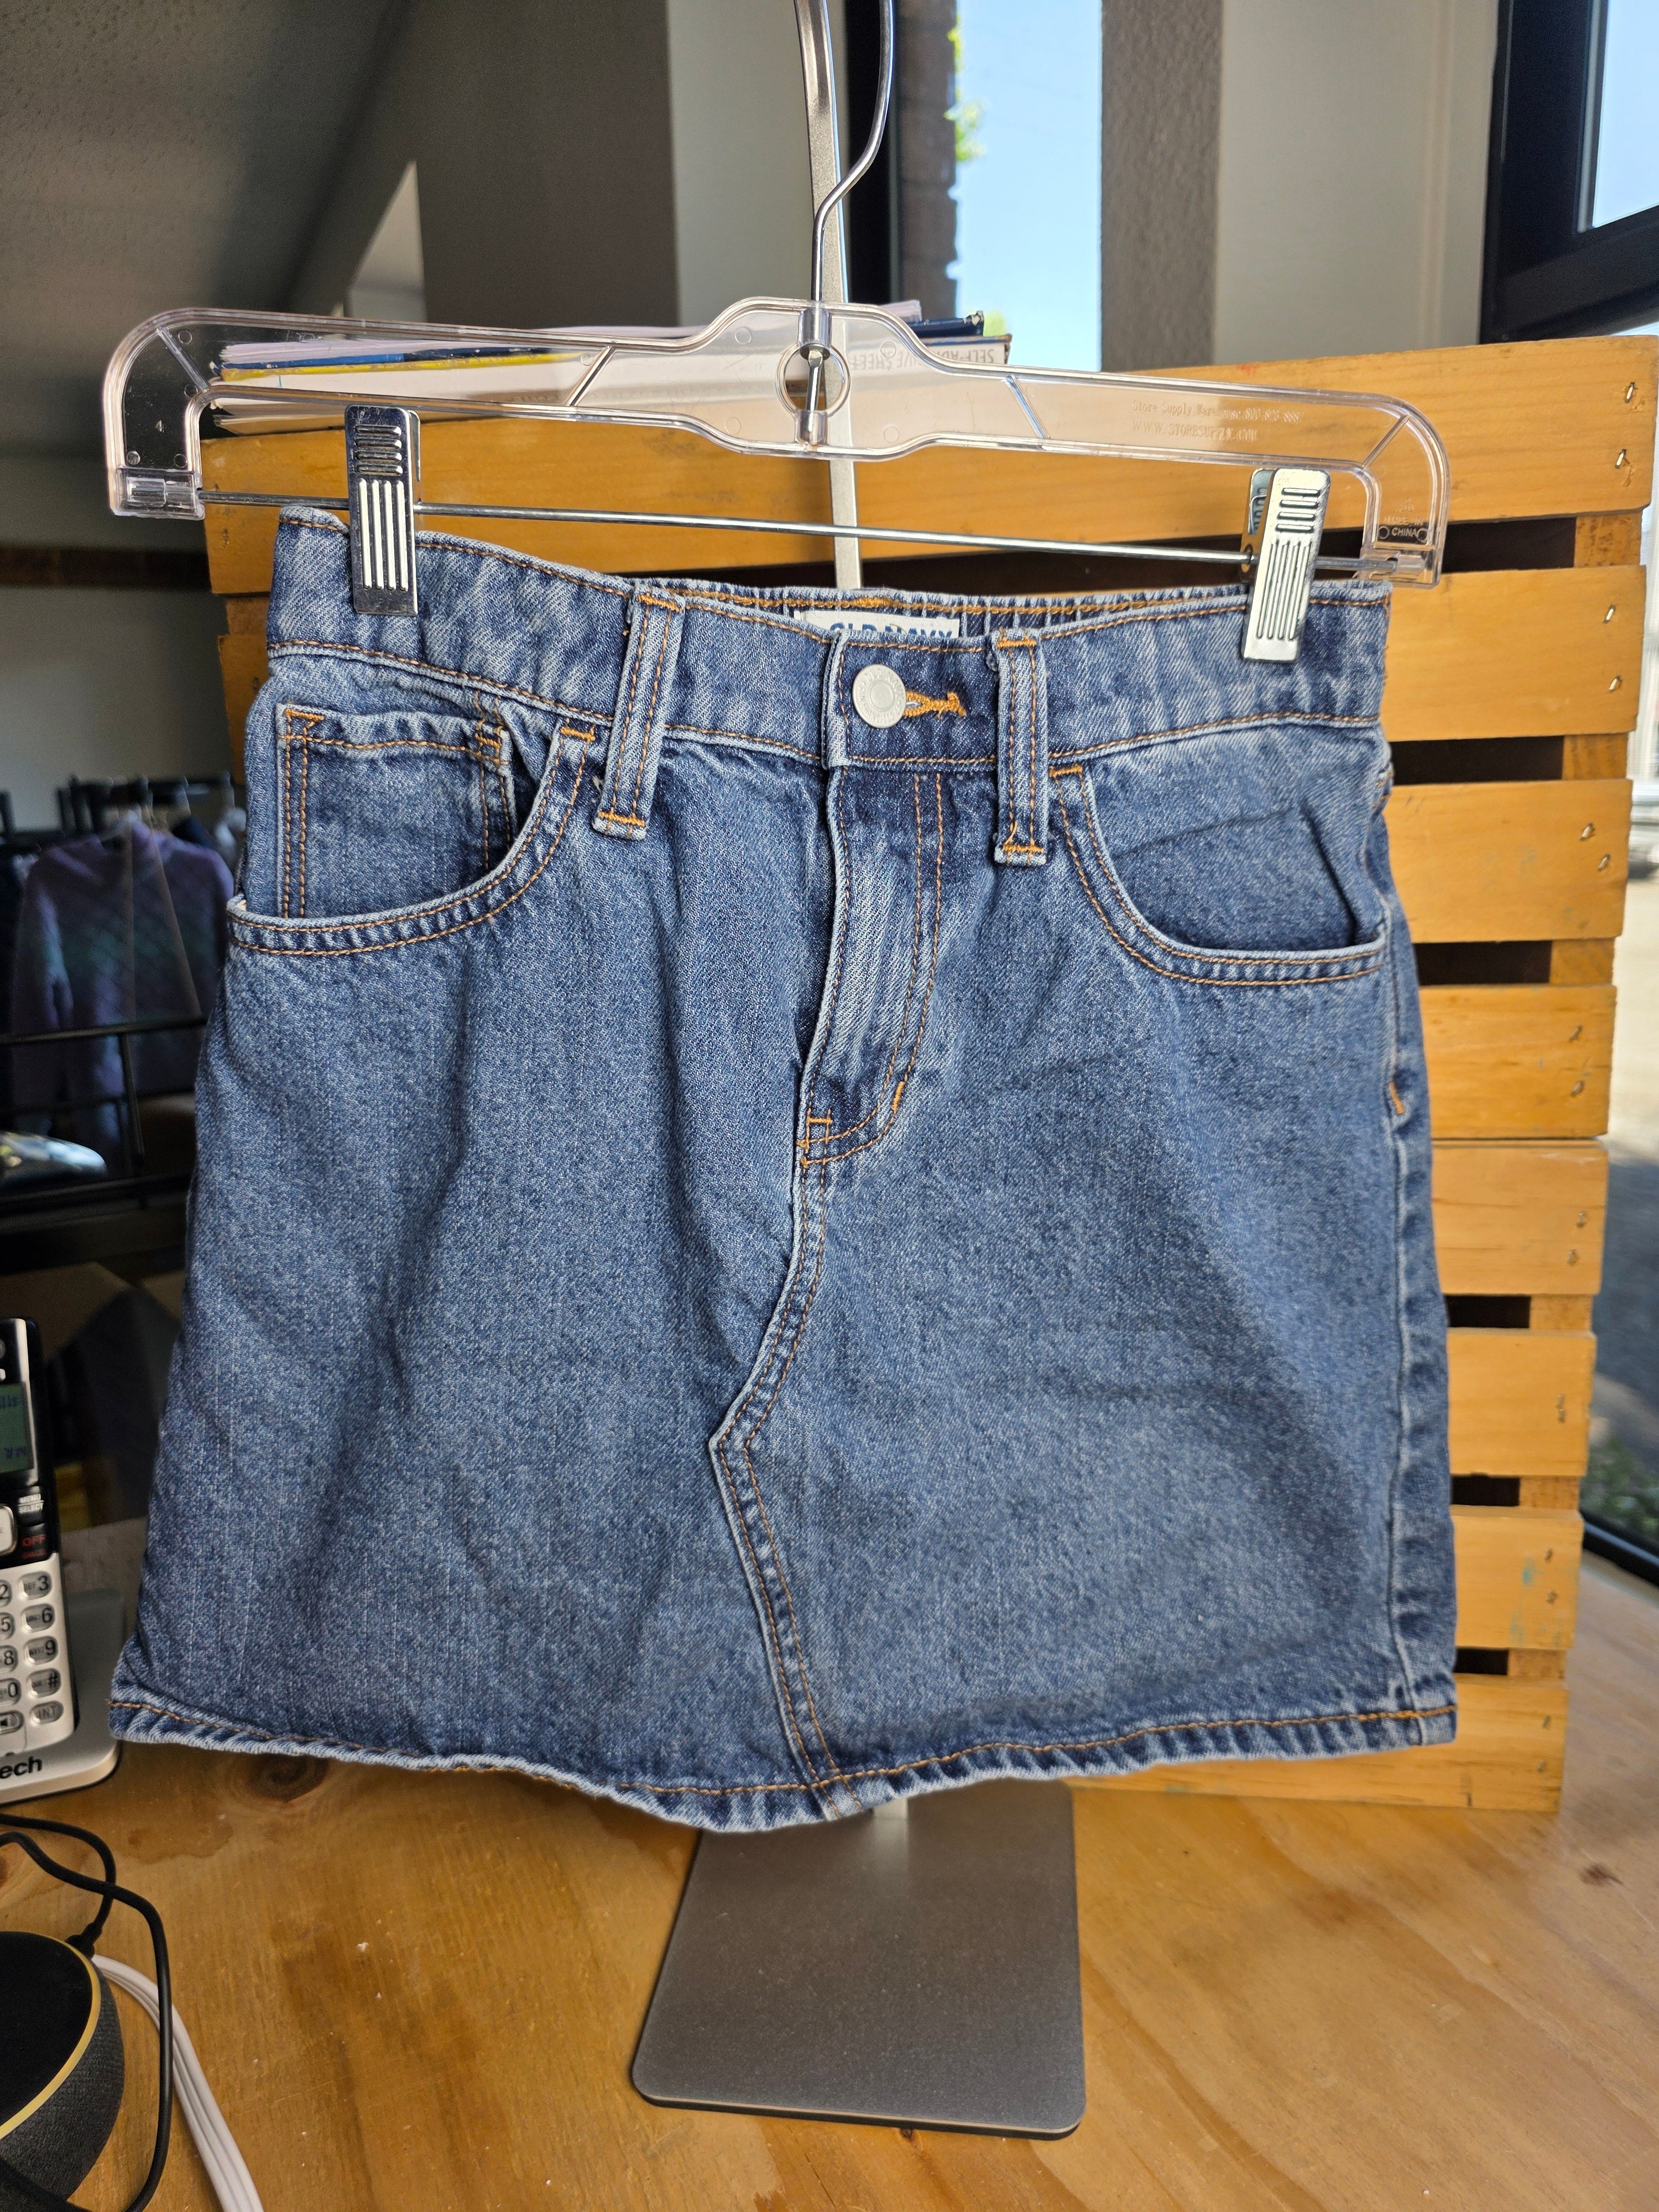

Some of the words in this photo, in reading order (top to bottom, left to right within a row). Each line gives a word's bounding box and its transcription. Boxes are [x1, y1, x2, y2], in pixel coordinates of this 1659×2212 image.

[1132, 400, 1158, 413] Store
[1162, 401, 1192, 416] Supply
[1391, 527, 1417, 538] CHINA
[864, 668, 883, 682] OLD
[885, 671, 904, 699] NAVY
[22, 1535, 45, 1547] OFF
[38, 1575, 49, 1590] 3
[0, 1584, 9, 1599] 2
[42, 1607, 53, 1623] 6
[1, 1616, 11, 1631] 5
[45, 1640, 55, 1655] 9
[4, 1650, 14, 1665] 8
[8, 1682, 18, 1697] 0
[38, 1706, 56, 1719] INT
[0, 1756, 43, 1778] ech
